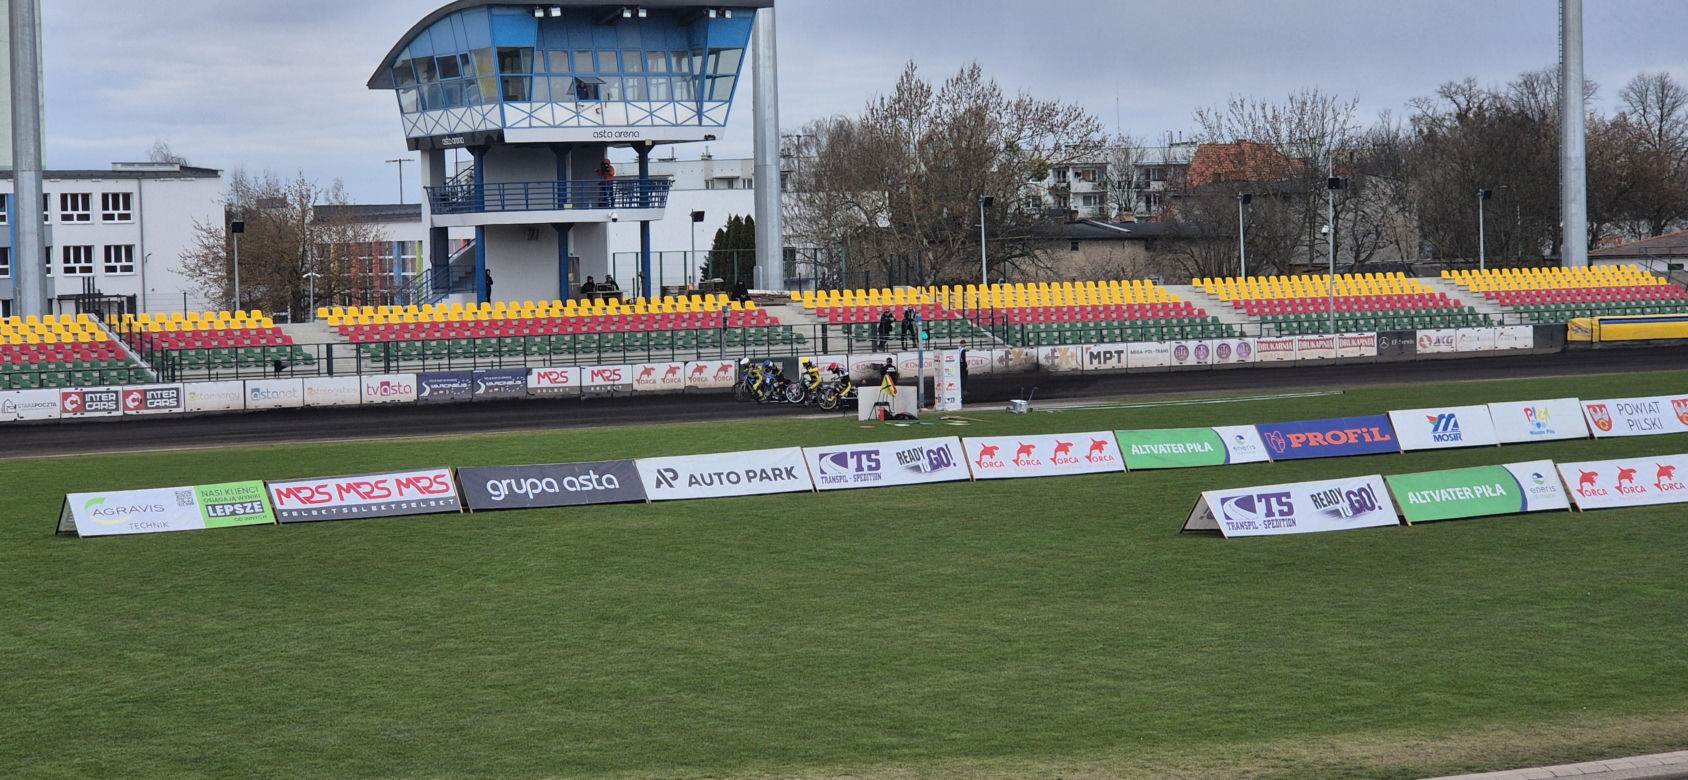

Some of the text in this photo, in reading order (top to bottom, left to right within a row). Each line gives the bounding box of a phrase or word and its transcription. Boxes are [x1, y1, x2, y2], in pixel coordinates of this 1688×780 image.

[592, 130, 640, 139] asta arena
[1257, 342, 1293, 350] DRUKARNIA
[1089, 350, 1124, 365] MPT
[537, 370, 569, 385] MRS
[591, 368, 622, 382] MRS
[146, 390, 177, 399] INTER
[366, 381, 412, 396] tvasta
[85, 393, 116, 401] INTER
[146, 399, 178, 408] CARS
[85, 401, 117, 410] CARS
[1617, 401, 1660, 416] POWIAT
[1627, 417, 1663, 432] PILSKI
[1287, 427, 1391, 448] PROFiL
[1433, 433, 1463, 442] MOSIR
[896, 446, 925, 465] READY
[1131, 442, 1213, 455] ALTVATER PIŁA
[850, 450, 881, 472] TS
[926, 443, 957, 471] GO!
[1092, 454, 1116, 463] ORCA
[688, 466, 798, 487] AUTO PARK
[820, 475, 849, 484] TRANSPIL
[853, 473, 882, 482] SPEDITION
[201, 486, 259, 498] NASI KLIENCI
[275, 474, 450, 506] MRS MRS MRS
[486, 470, 619, 501] grupa asta
[1584, 488, 1608, 497] ORCA
[1622, 485, 1647, 494] ORCA
[1662, 482, 1686, 491] ORCA
[1310, 487, 1345, 510] READY
[1345, 483, 1383, 516] GO!
[1407, 482, 1507, 505] ALTVATER PIŁA
[93, 505, 165, 517] AGRAVIS
[207, 501, 263, 517] LEPSZE
[282, 499, 455, 517] SELECT SELECT SELECT
[1257, 492, 1295, 518] TS
[128, 522, 169, 530] TECHNIK
[1226, 520, 1258, 531] TRANSPIL
[1263, 517, 1297, 528] SPEDITION
